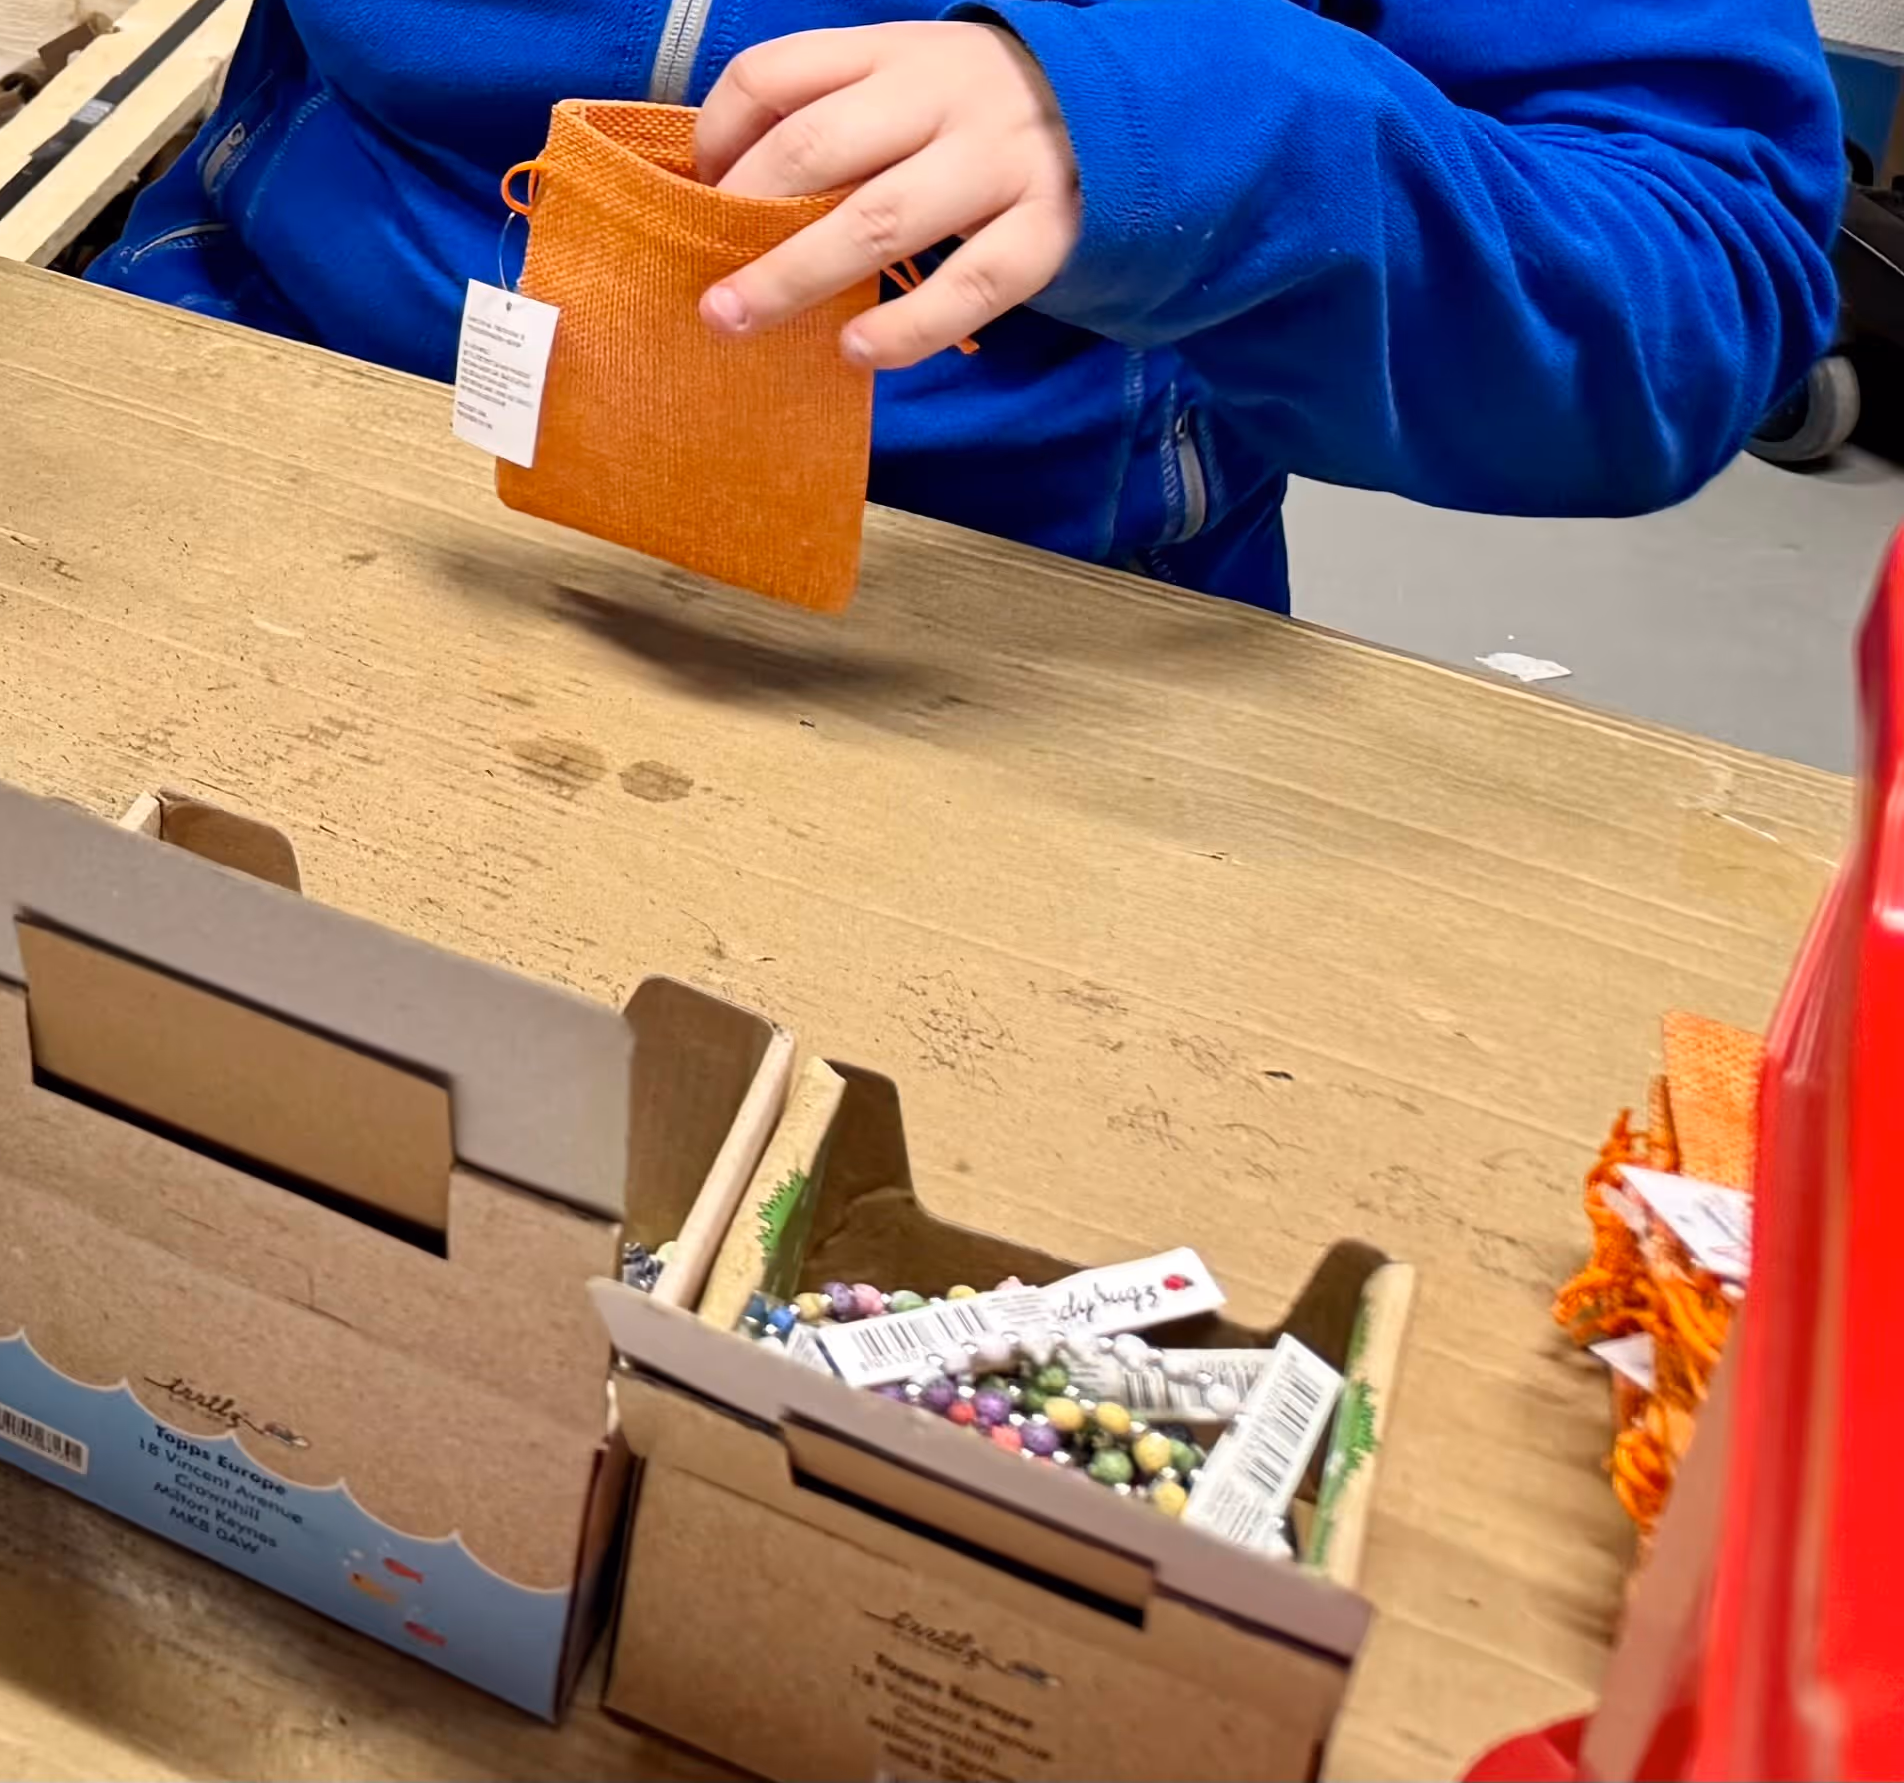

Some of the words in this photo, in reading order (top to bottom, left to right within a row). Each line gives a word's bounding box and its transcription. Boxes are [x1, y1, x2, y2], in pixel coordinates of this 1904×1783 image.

[139, 1435, 159, 1456] 18
[165, 1450, 230, 1489] Vincent
[236, 1485, 303, 1525] Avenue
[155, 1423, 211, 1460] Topps
[217, 1454, 286, 1496] Europe
[154, 1481, 209, 1515] Milton
[175, 1473, 260, 1521] Crownhill
